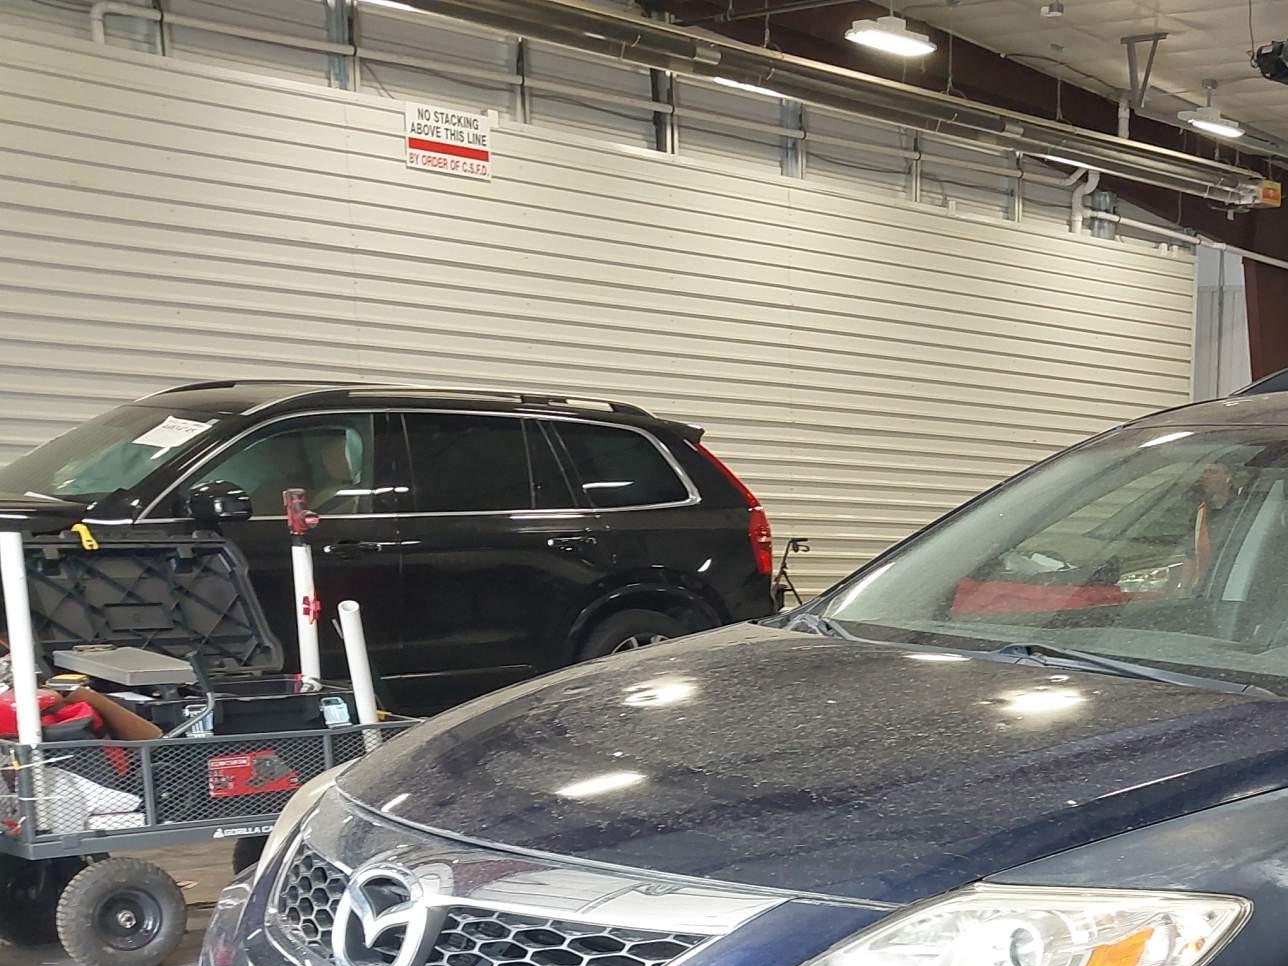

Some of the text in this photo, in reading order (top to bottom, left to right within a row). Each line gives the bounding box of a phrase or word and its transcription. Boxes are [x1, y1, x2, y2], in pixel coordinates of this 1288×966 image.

[416, 107, 479, 130] NO STACKING
[410, 121, 487, 147] ABOVE THIS LINE
[408, 152, 419, 164] BY
[421, 154, 448, 169] ORDER
[450, 159, 460, 171] OF
